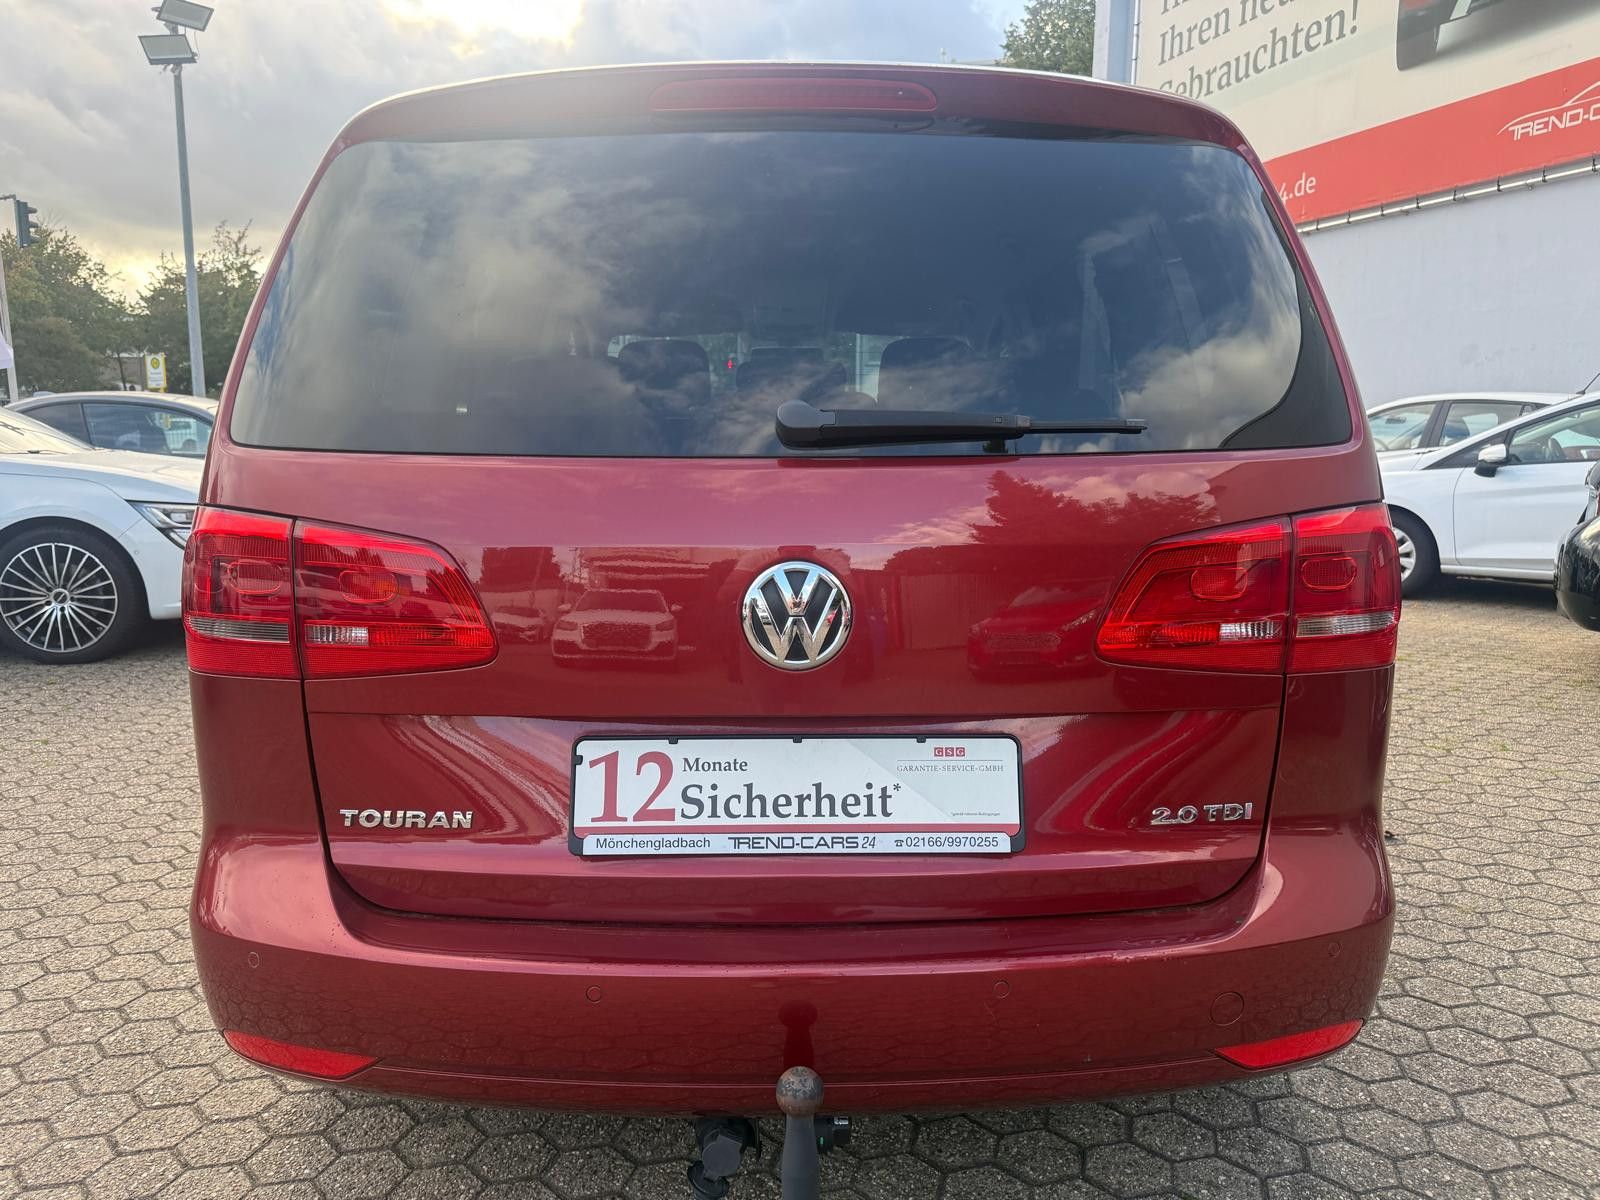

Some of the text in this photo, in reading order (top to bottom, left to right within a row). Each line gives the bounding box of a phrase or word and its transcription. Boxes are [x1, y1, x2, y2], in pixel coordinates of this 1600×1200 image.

[1158, 0, 1295, 66] Ihren ne
[934, 747, 966, 757] GSG
[683, 758, 748, 772] Monate
[588, 750, 676, 823] 12
[340, 809, 473, 828] TOURAN
[1151, 803, 1253, 825] 2.0 TDI
[596, 837, 711, 850] Mönchengladbach
[905, 836, 999, 848] 02166/9970255
